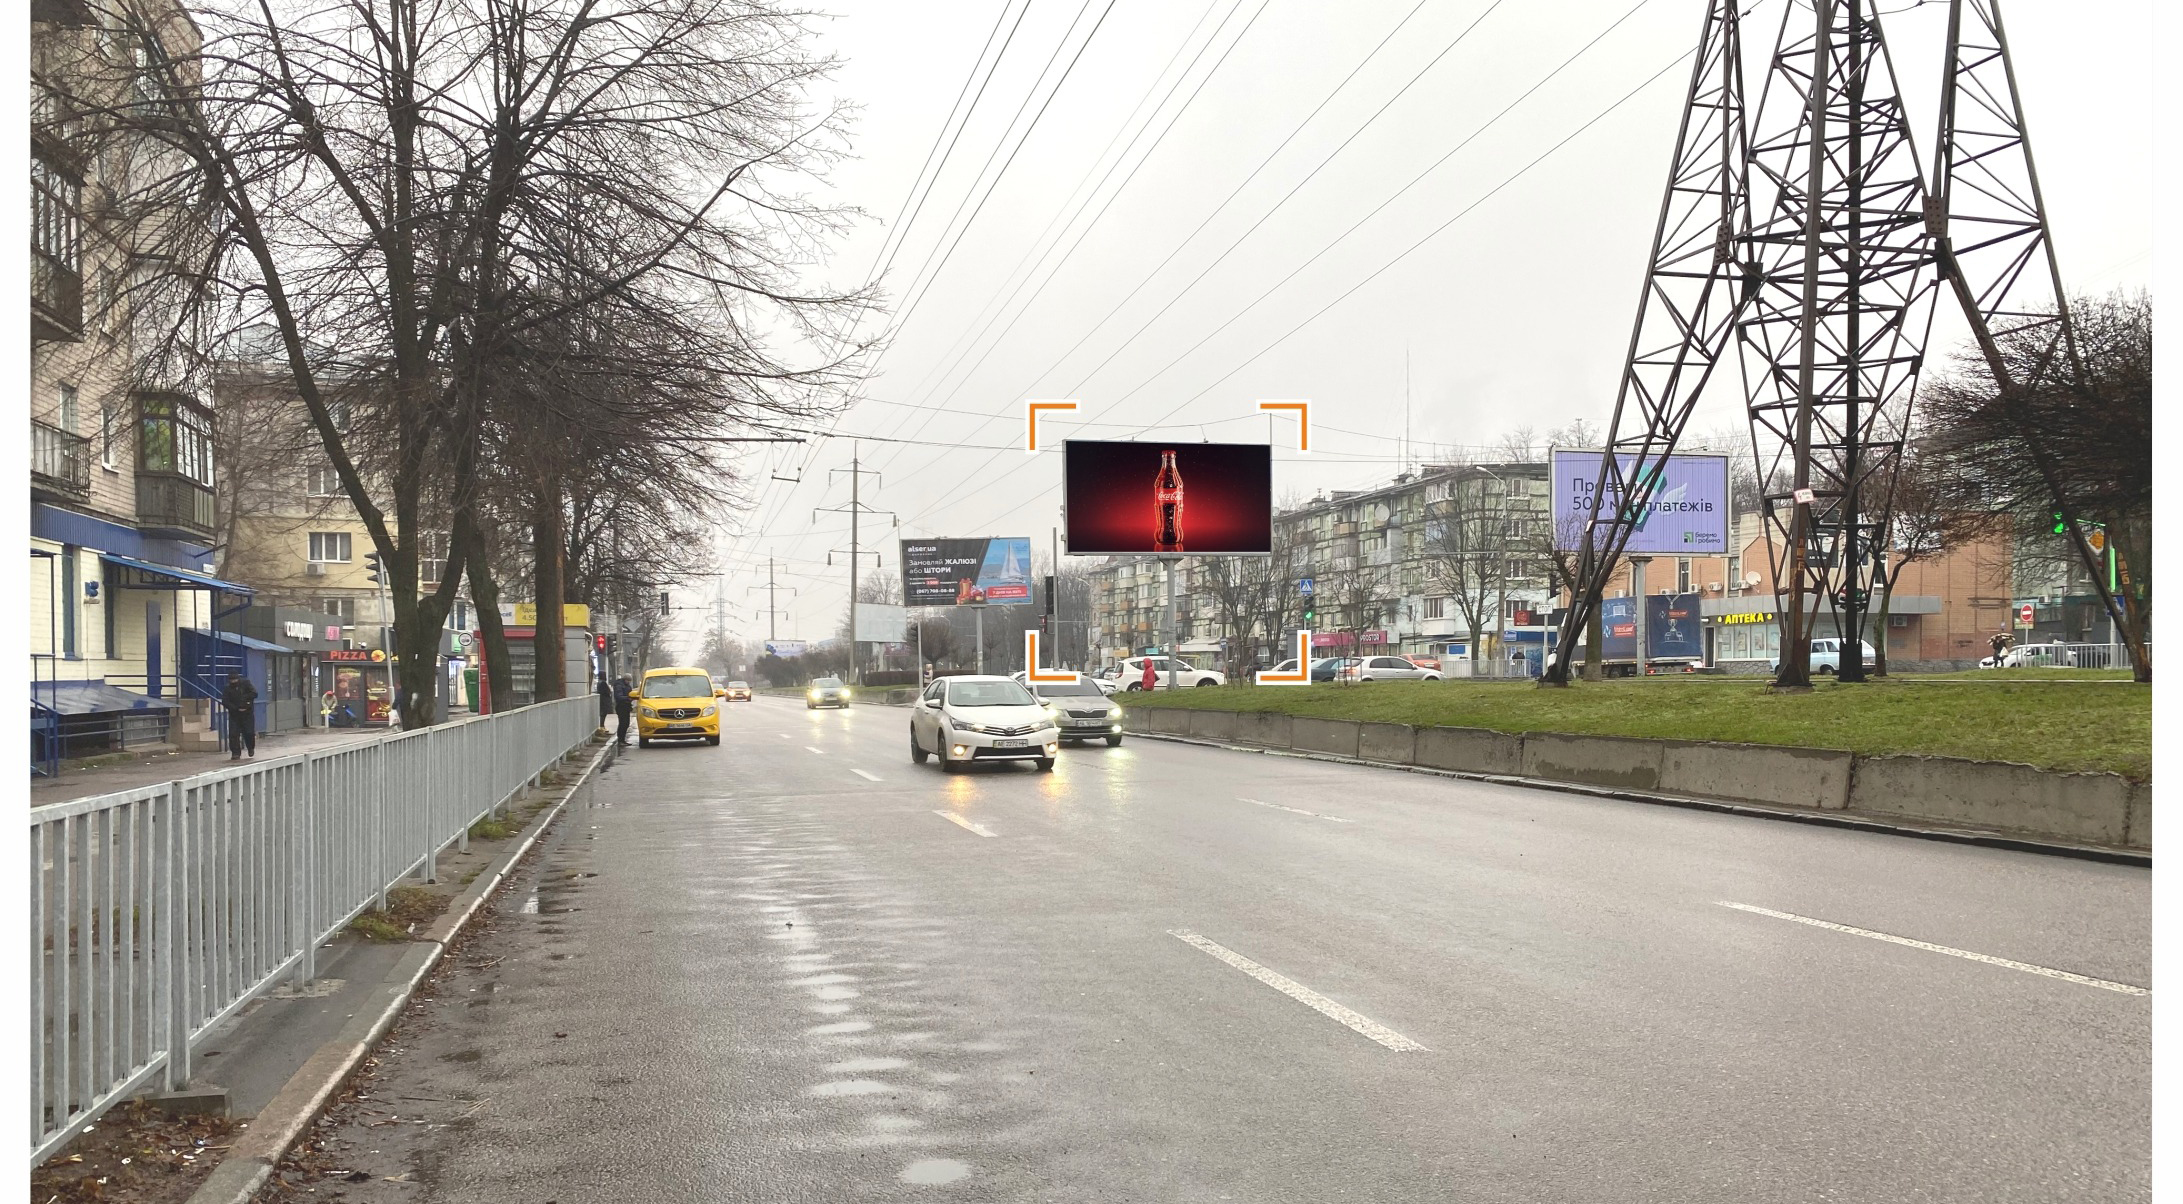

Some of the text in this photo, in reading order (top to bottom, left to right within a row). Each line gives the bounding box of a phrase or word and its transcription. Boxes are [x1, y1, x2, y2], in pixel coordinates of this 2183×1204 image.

[1645, 498, 1713, 512] платежів
[923, 566, 952, 574] ШТОРИ
[1724, 612, 1765, 625] АПТЕКА
[330, 650, 367, 660] PIZZA
